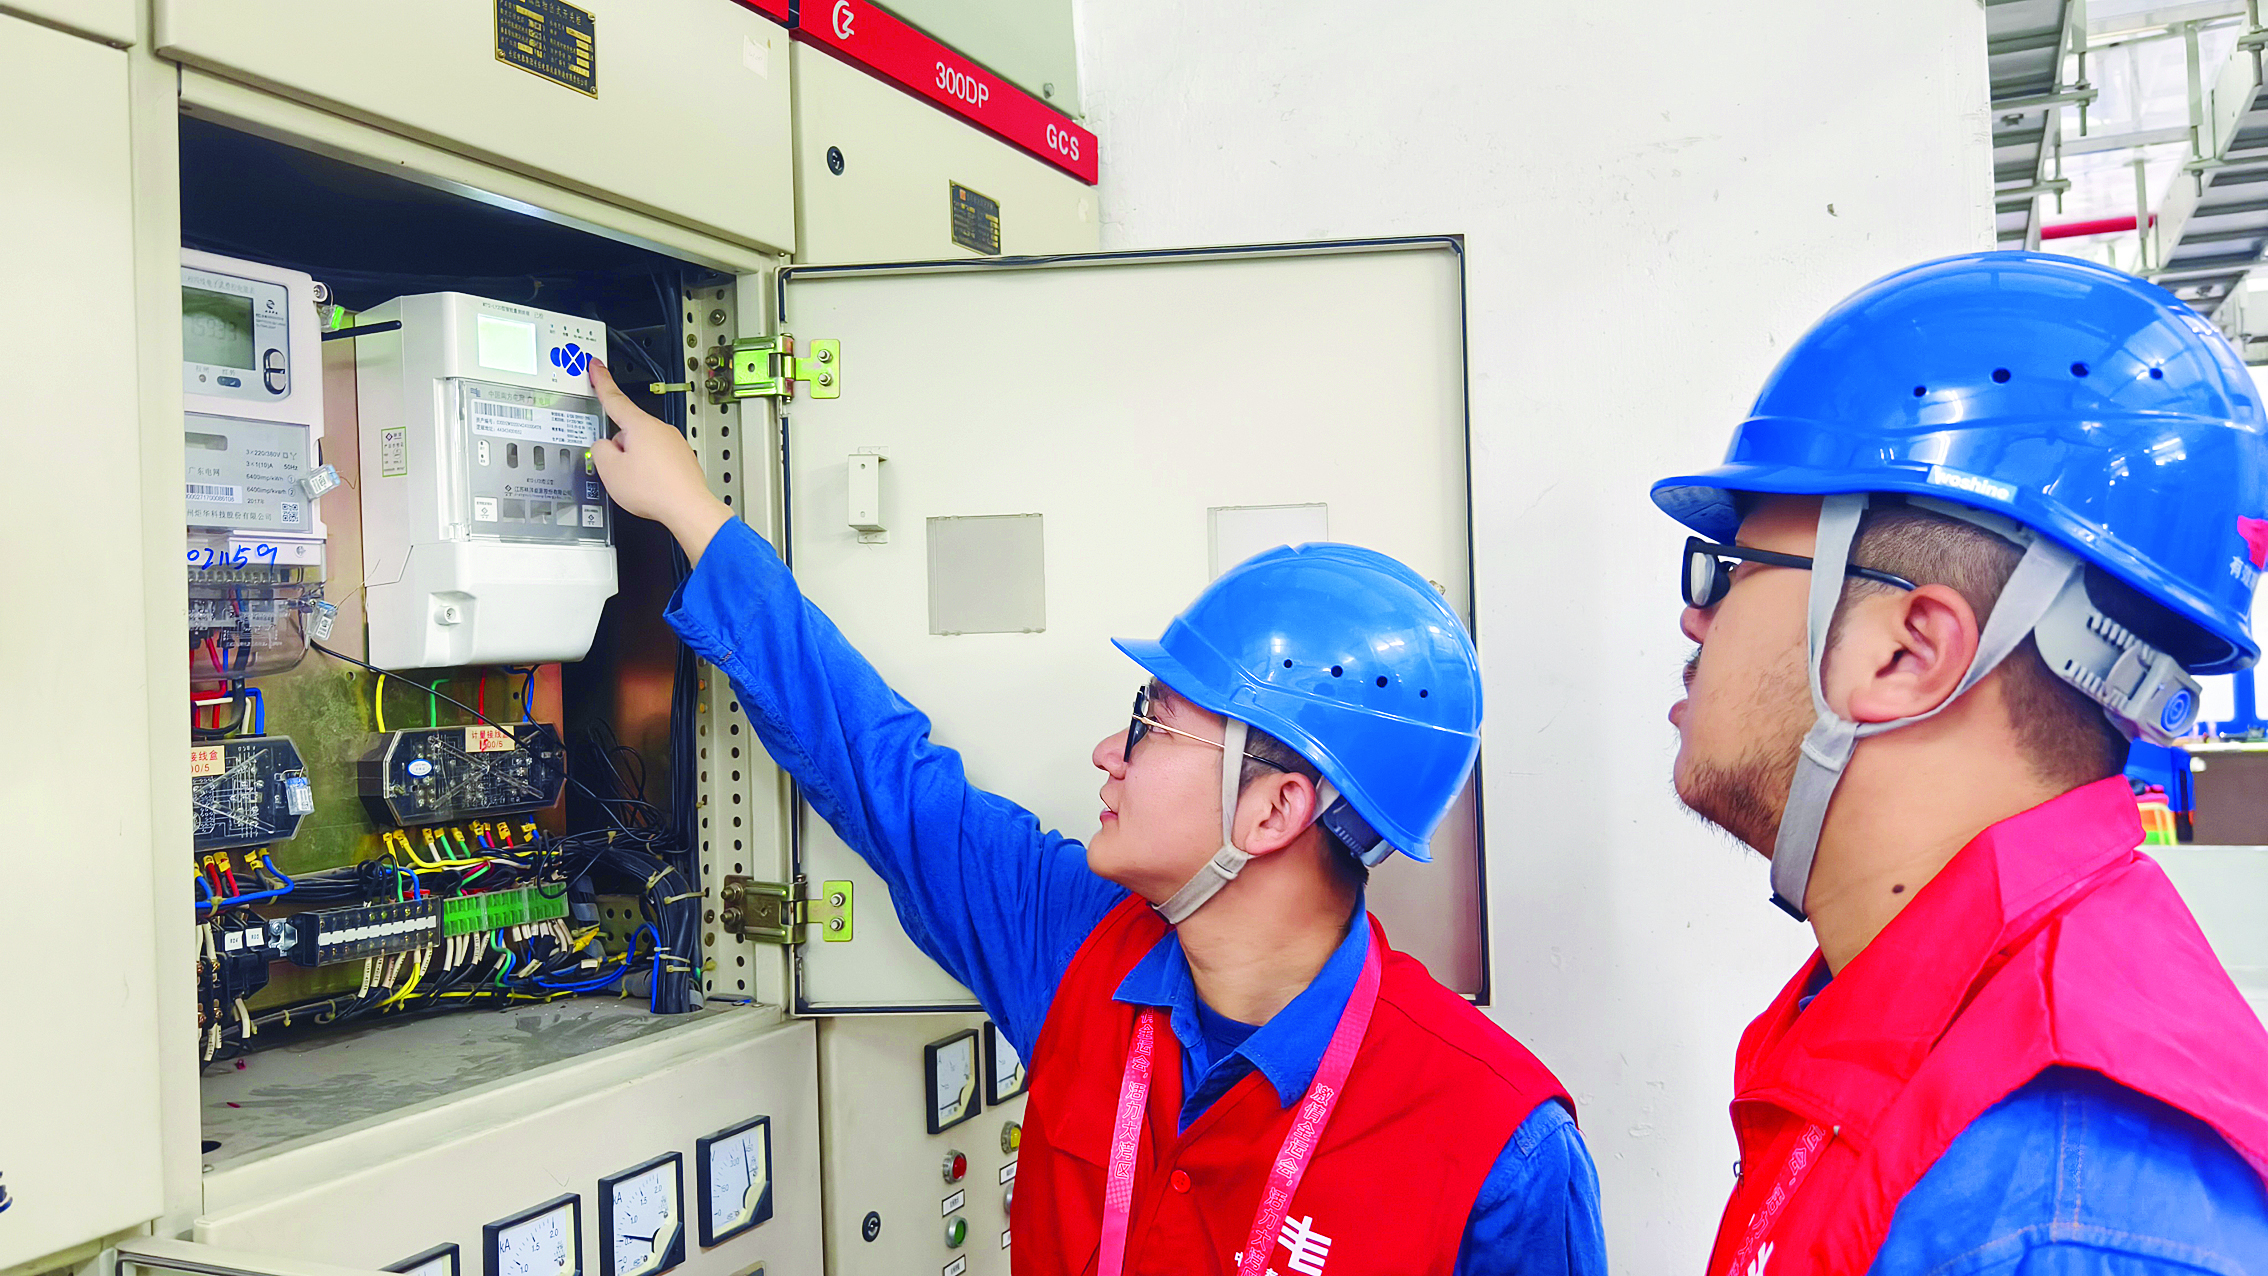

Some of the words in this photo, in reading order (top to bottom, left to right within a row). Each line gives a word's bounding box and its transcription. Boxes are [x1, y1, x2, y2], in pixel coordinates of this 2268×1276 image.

[935, 61, 990, 109] 300DP
[1046, 123, 1080, 162] GCS
[471, 730, 509, 739] 计量接线
[549, 1228, 559, 1239] 2.0
[499, 1238, 511, 1254] kA
[531, 1241, 541, 1252] 1.5
[520, 1263, 529, 1274] 1.0
